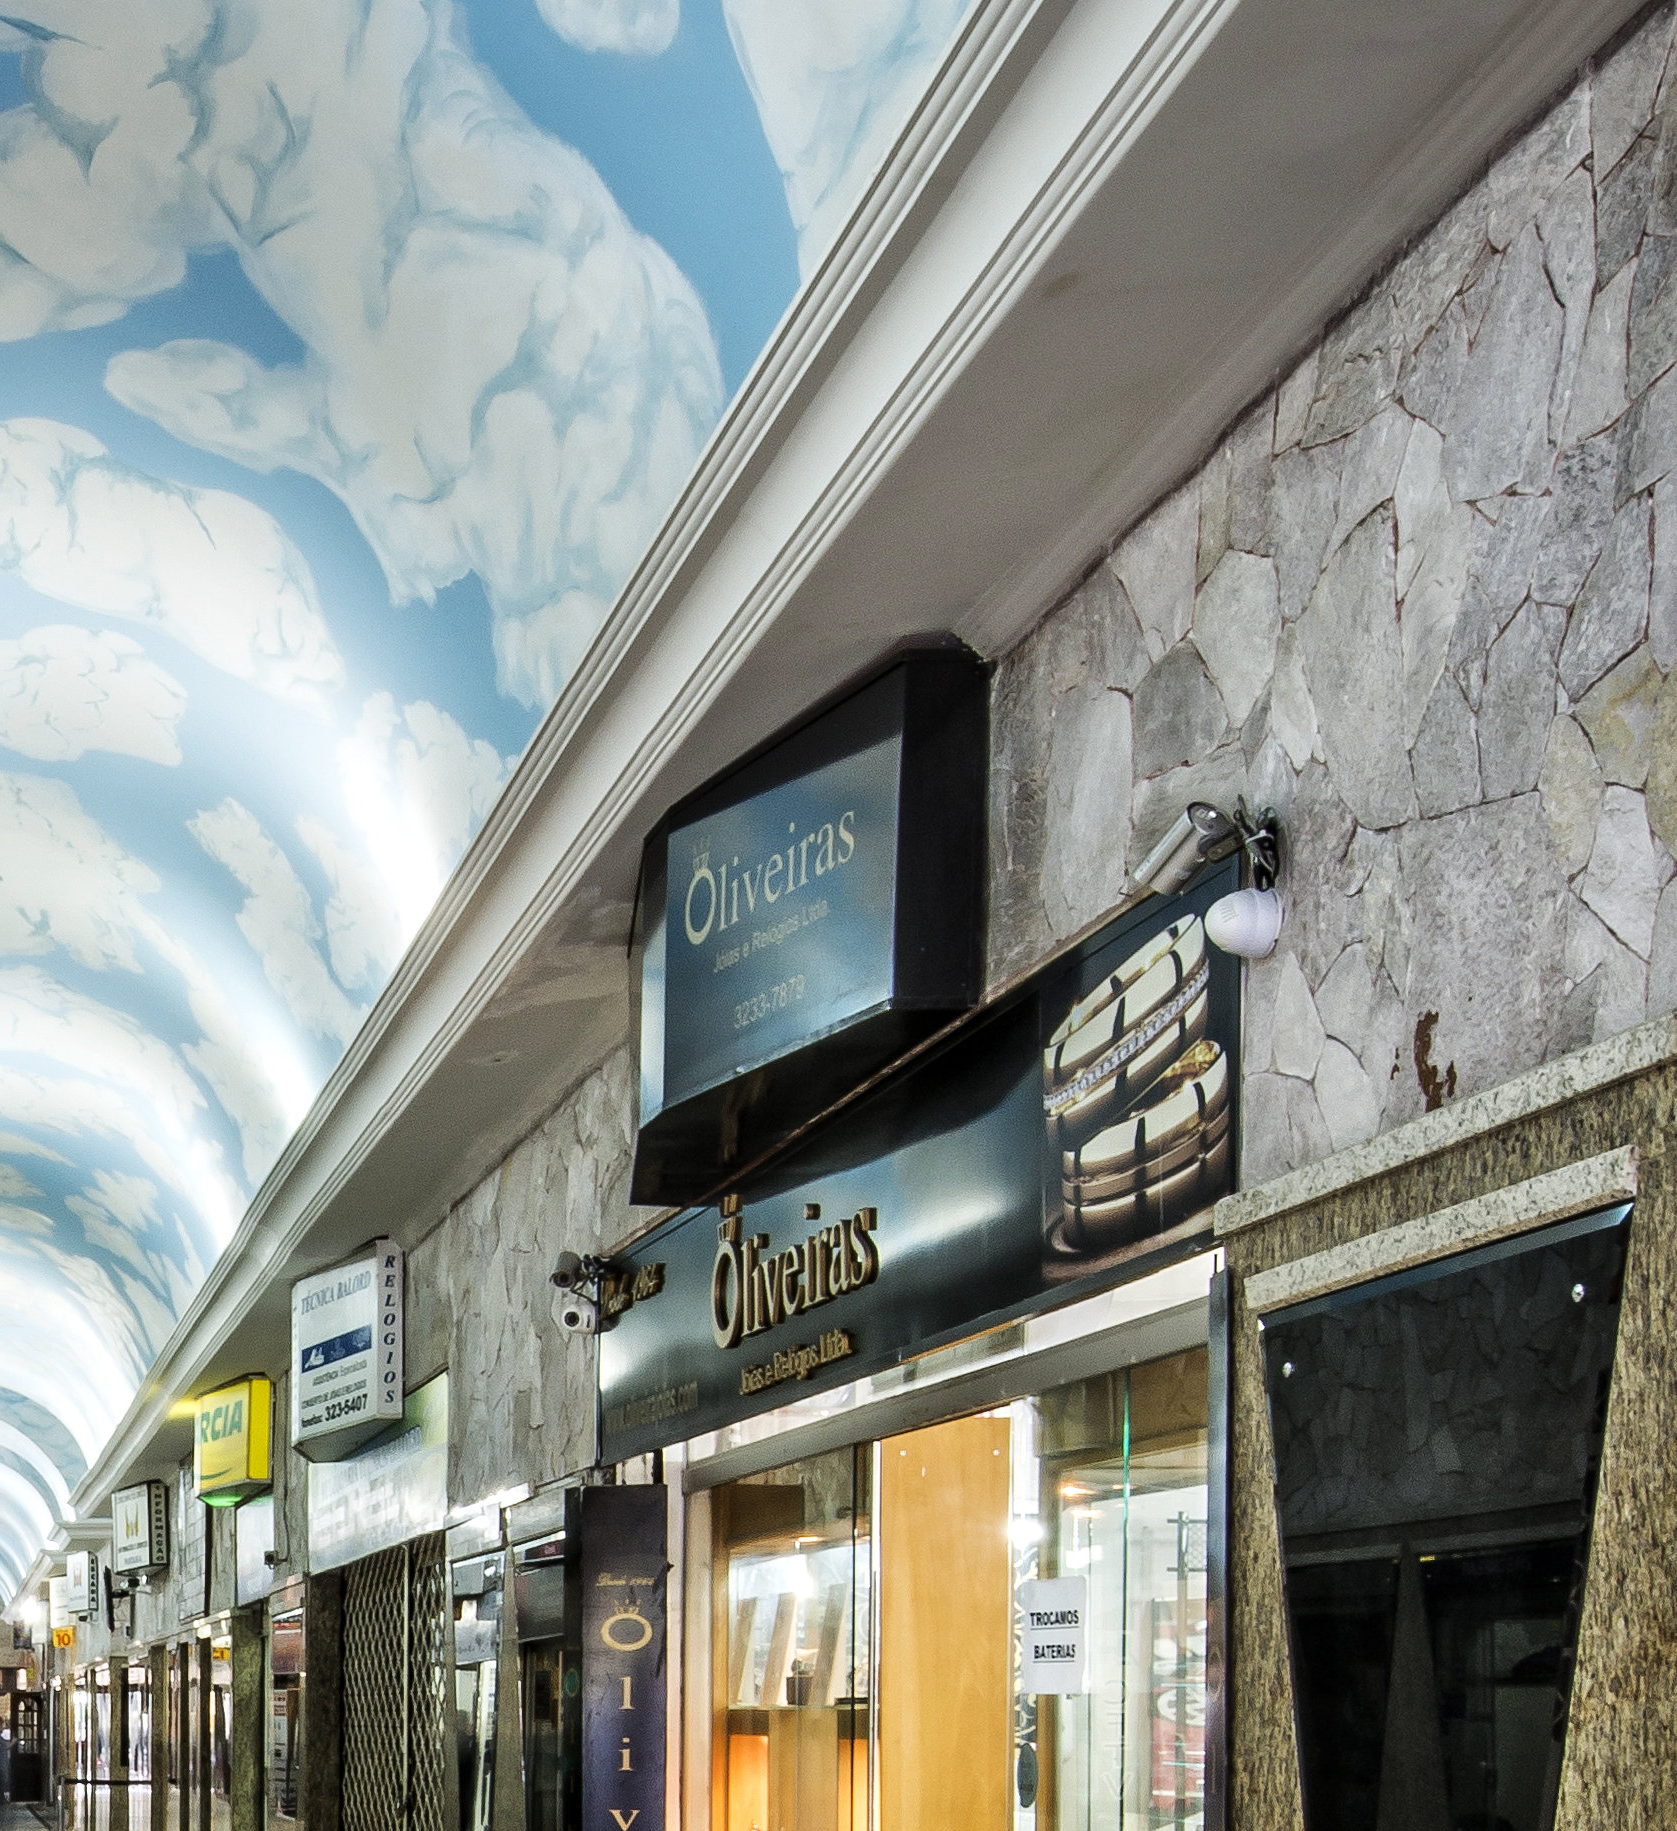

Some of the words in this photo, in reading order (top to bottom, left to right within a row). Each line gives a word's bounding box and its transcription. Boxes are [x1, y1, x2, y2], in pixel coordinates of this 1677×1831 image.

[685, 810, 855, 946] Oliveiras
[711, 1204, 880, 1349] Oliveiras
[383, 1255, 397, 1404] RELOGIOS
[324, 1393, 368, 1422] 323-5407
[1029, 1609, 1080, 1627] TROCAMOS
[56, 1633, 71, 1646] 10
[1033, 1643, 1077, 1660] BATERIAS
